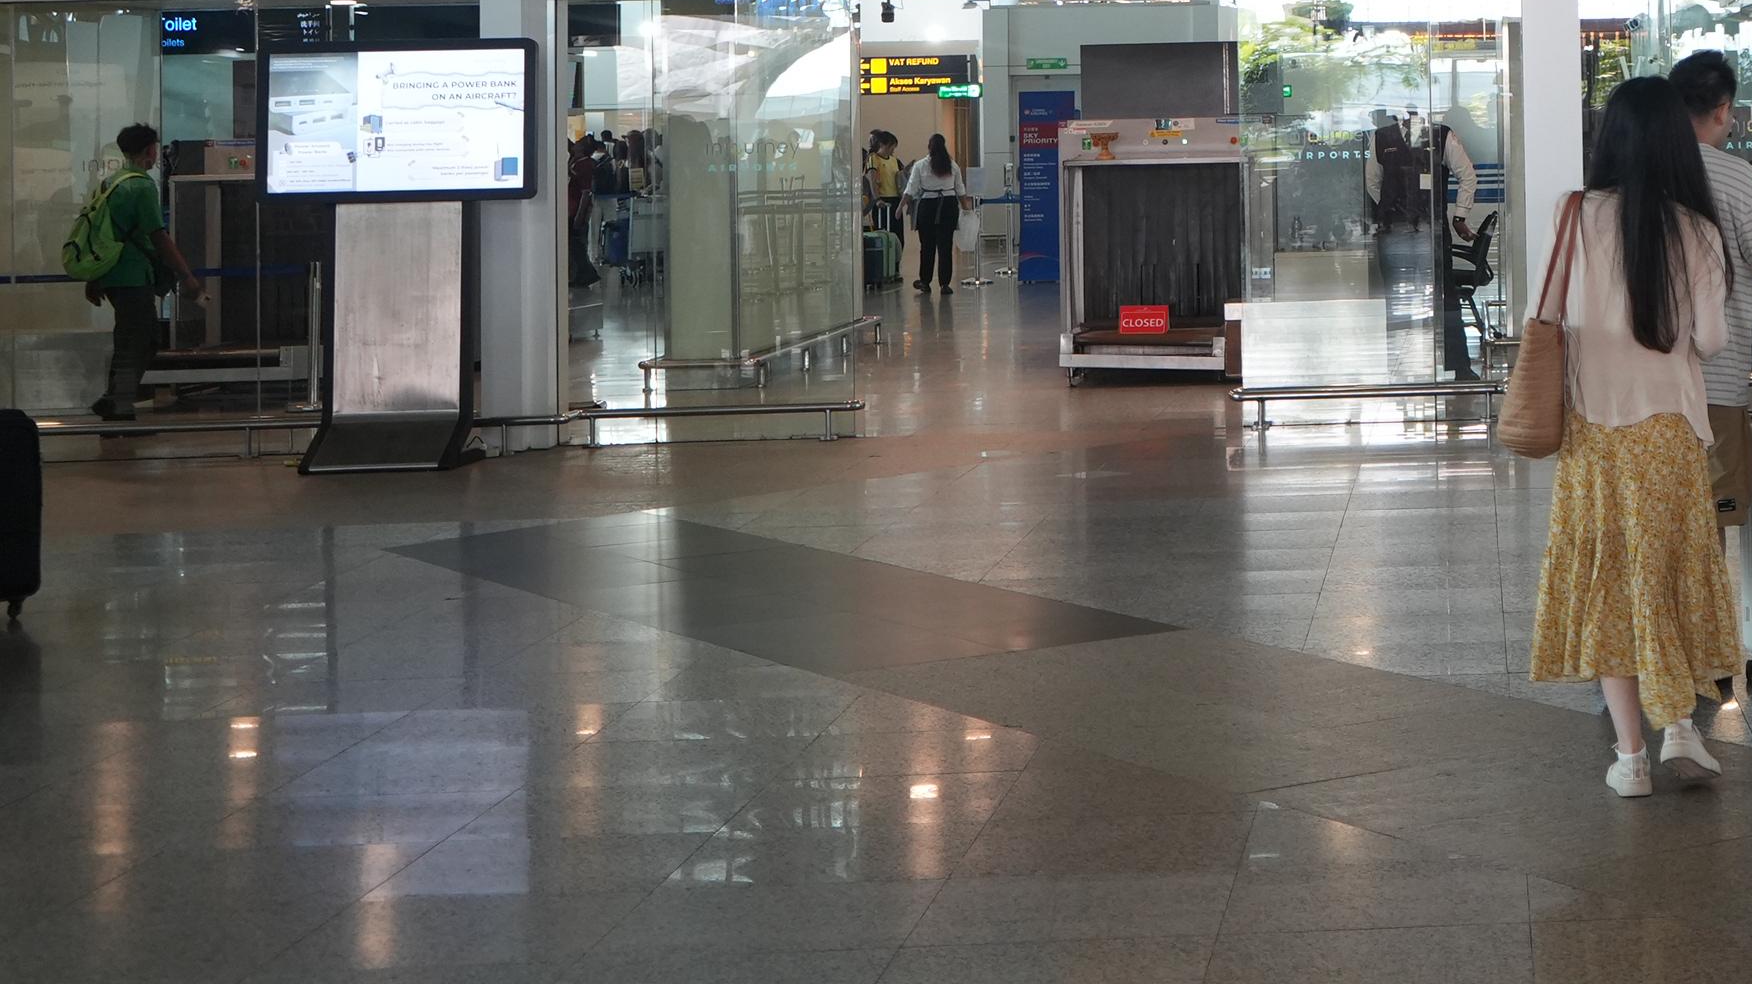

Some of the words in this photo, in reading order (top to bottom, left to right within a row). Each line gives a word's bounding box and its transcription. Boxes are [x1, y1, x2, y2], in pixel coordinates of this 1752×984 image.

[161, 38, 185, 47] oilets
[888, 58, 905, 66] VAT
[906, 57, 939, 66] REFUND
[393, 81, 440, 89] BRINGING
[442, 81, 449, 89] A
[451, 81, 488, 89] POWER
[490, 80, 517, 88] BANK
[432, 93, 447, 101] ON
[1122, 318, 1164, 328] CLOSED
